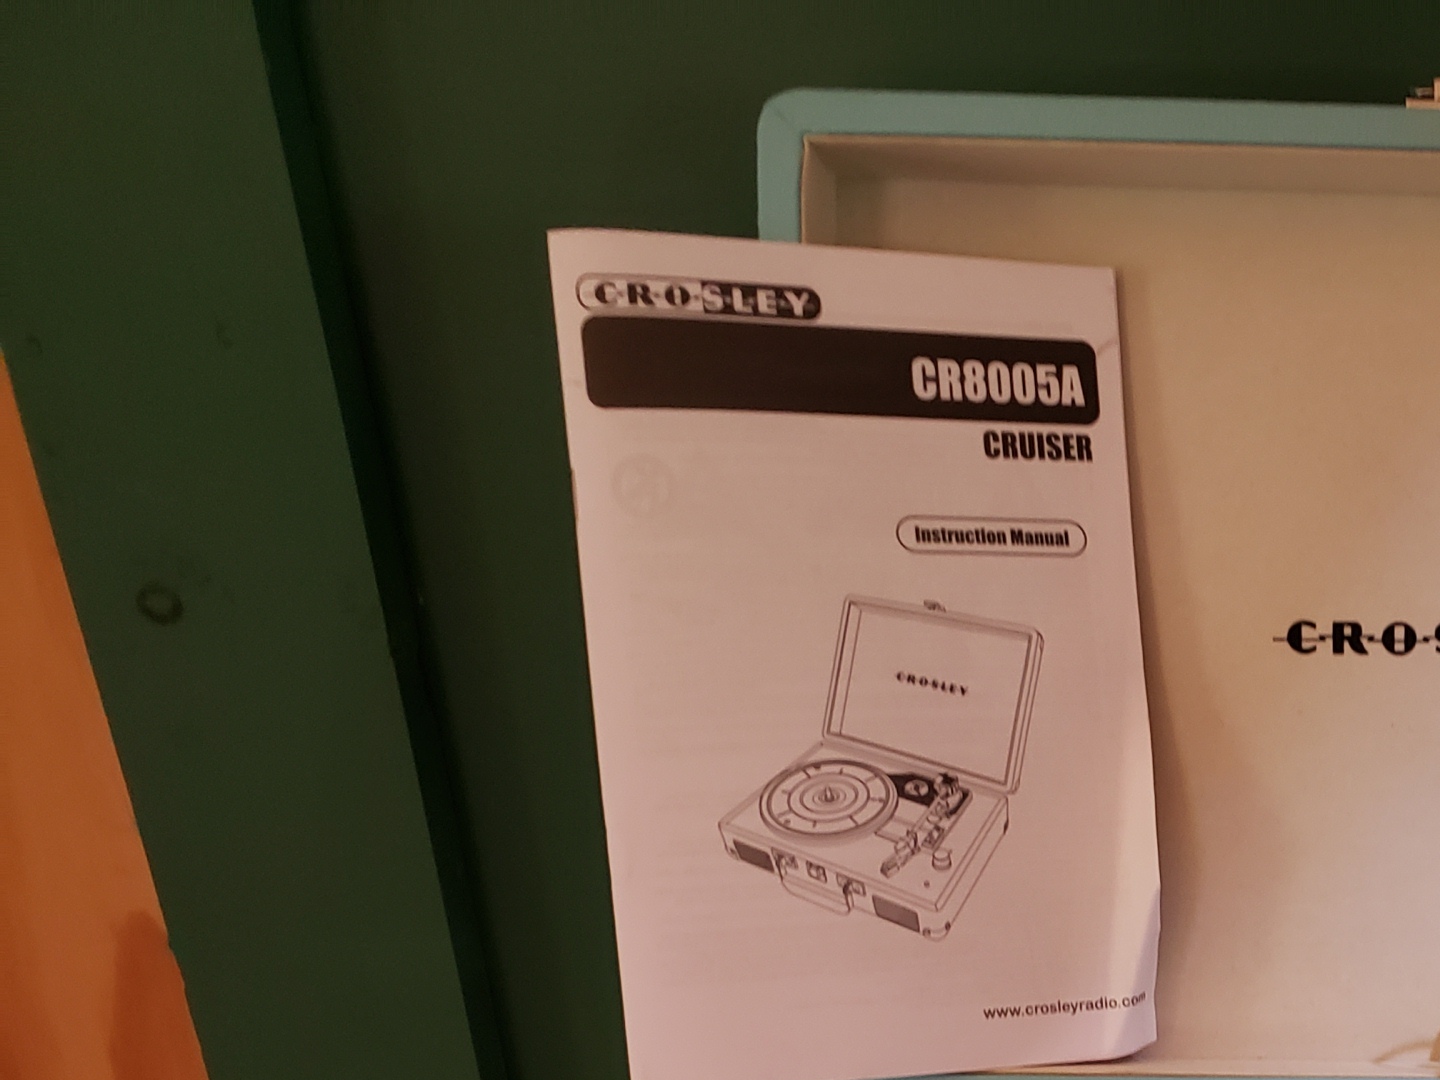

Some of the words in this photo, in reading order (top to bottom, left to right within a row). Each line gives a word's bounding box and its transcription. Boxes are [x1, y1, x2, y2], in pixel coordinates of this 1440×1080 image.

[593, 280, 812, 317] CROSLEY
[911, 356, 1085, 408] CR8005A
[983, 430, 1093, 462] CRUISER
[914, 526, 1007, 546] Instruction
[1010, 529, 1070, 547] Manual
[894, 671, 969, 697] CROSLEY
[983, 991, 1147, 1019] www.crosleyradio.com
